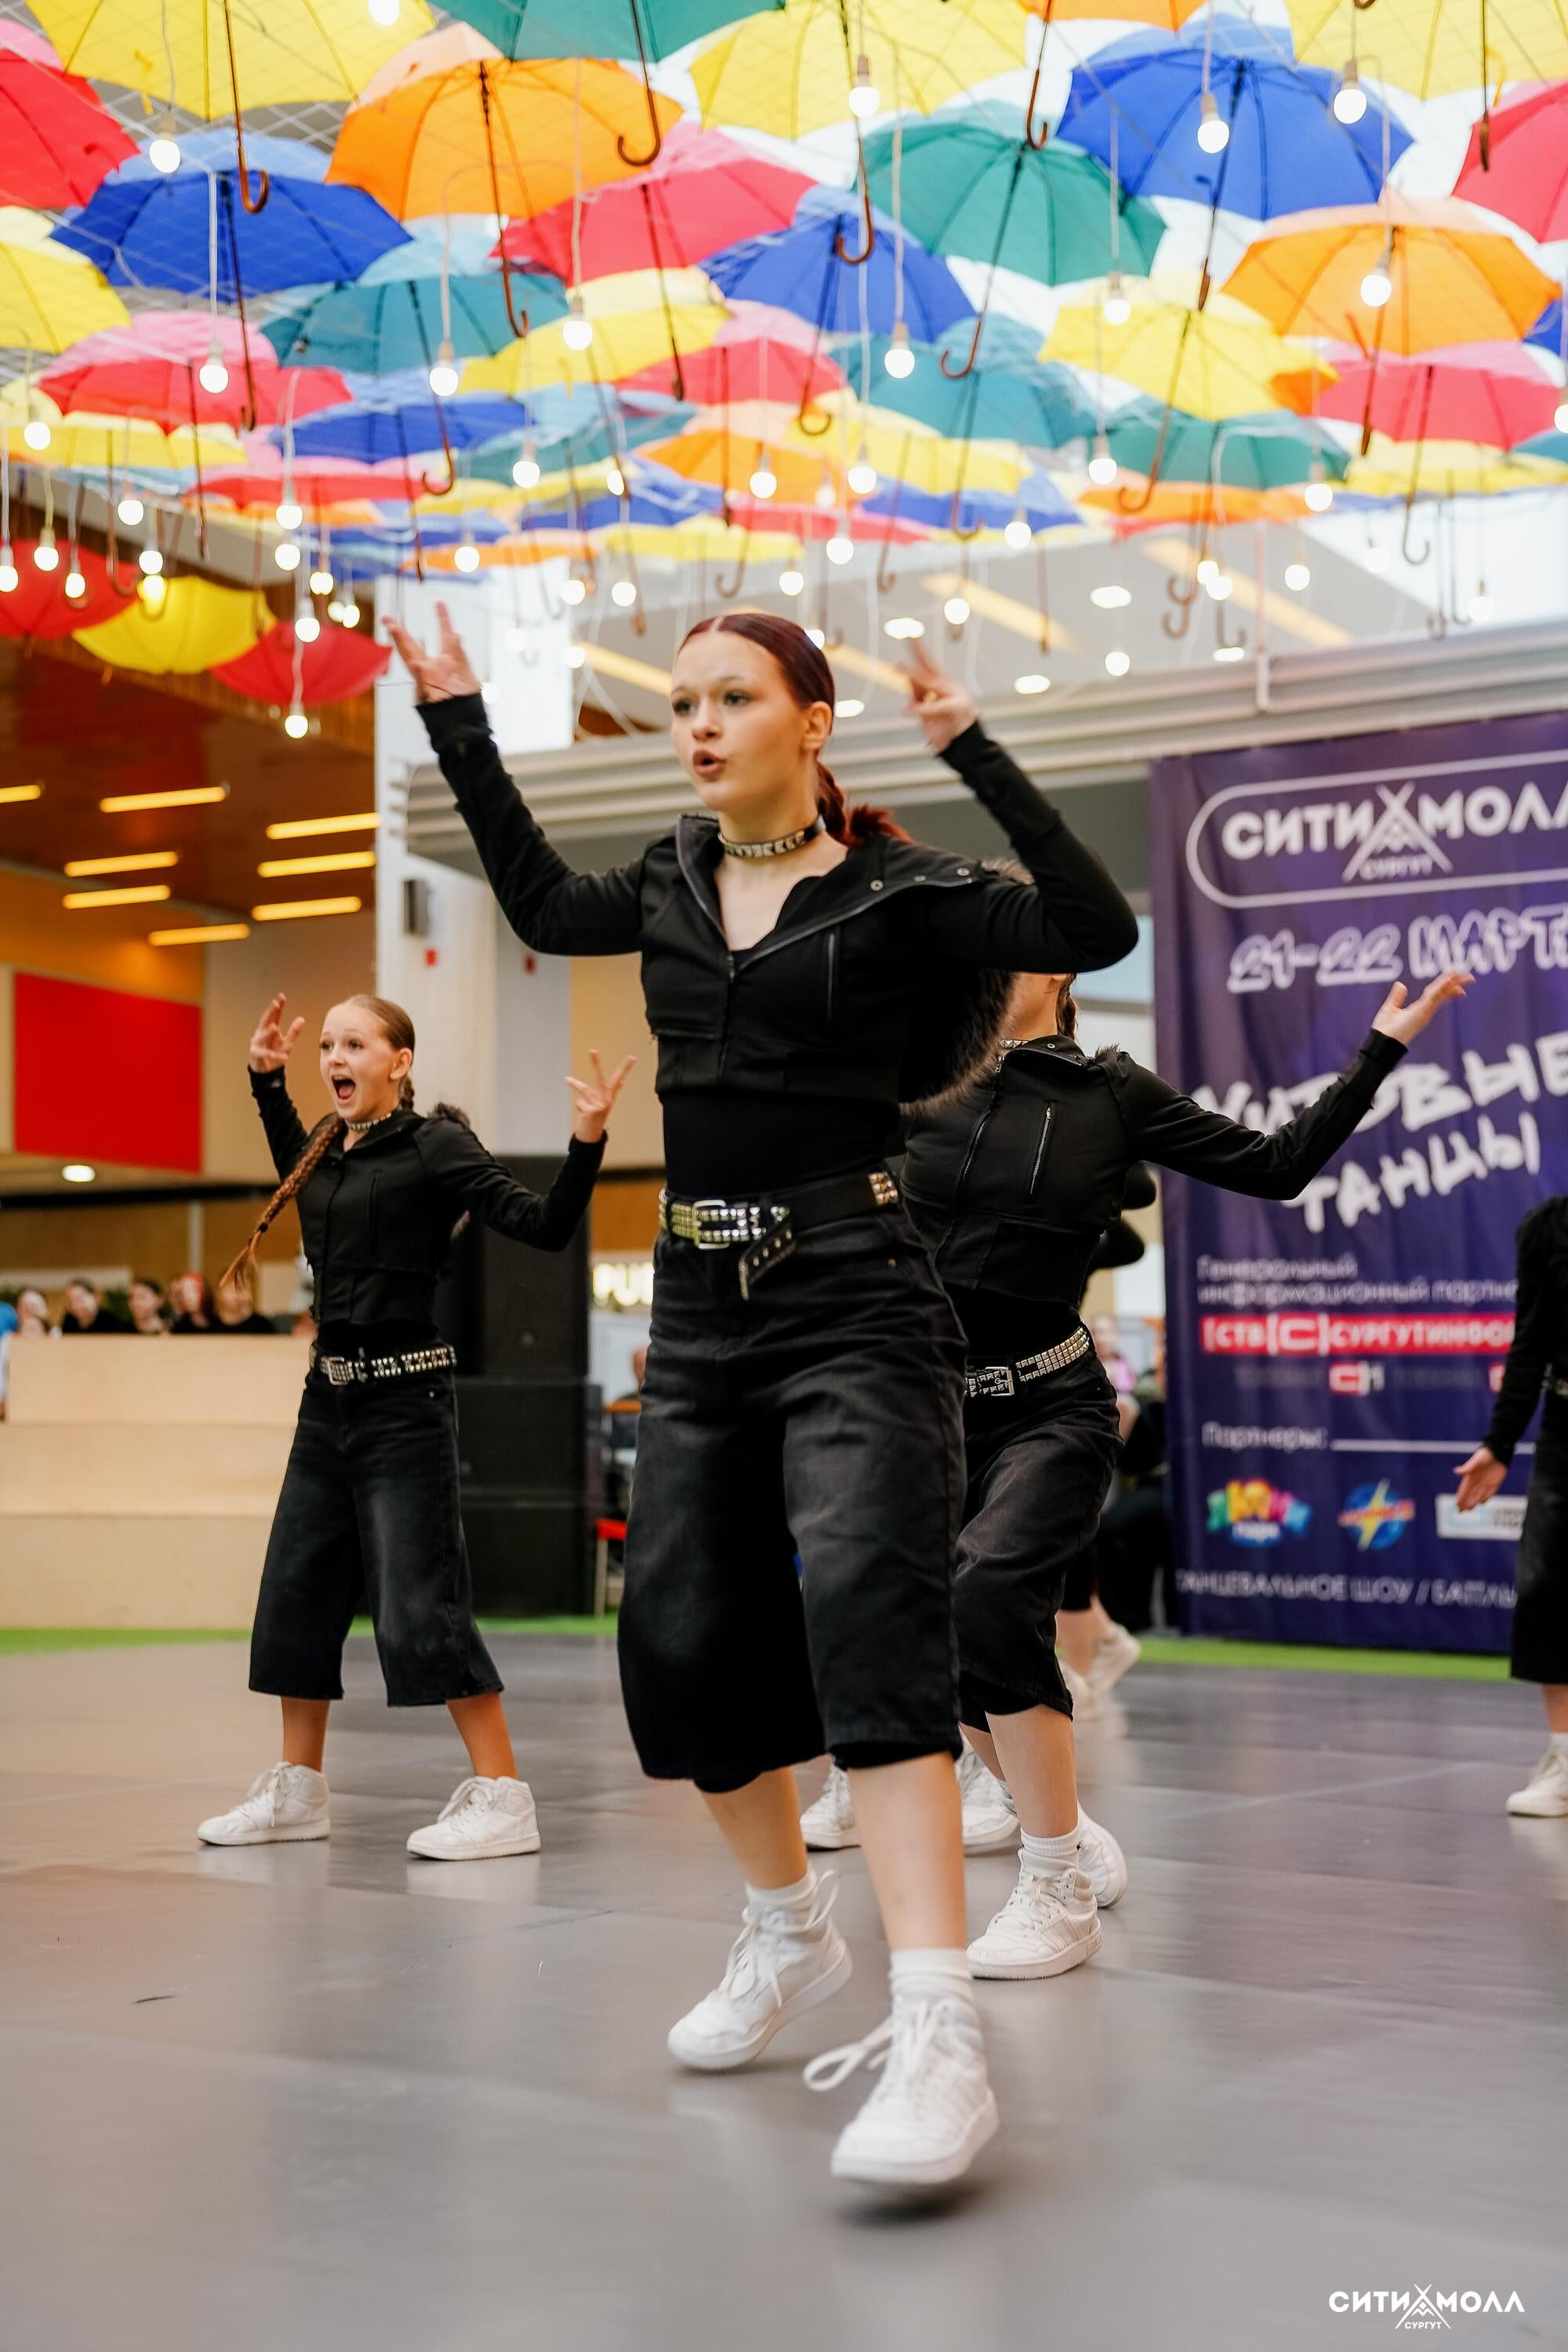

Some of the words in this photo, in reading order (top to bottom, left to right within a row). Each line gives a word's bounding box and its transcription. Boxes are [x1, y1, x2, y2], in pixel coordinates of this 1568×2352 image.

[1221, 800, 1374, 860] СИТИ
[1280, 1112, 1541, 1233] ТАНЦЫ
[1432, 1279, 1519, 1308] партне
